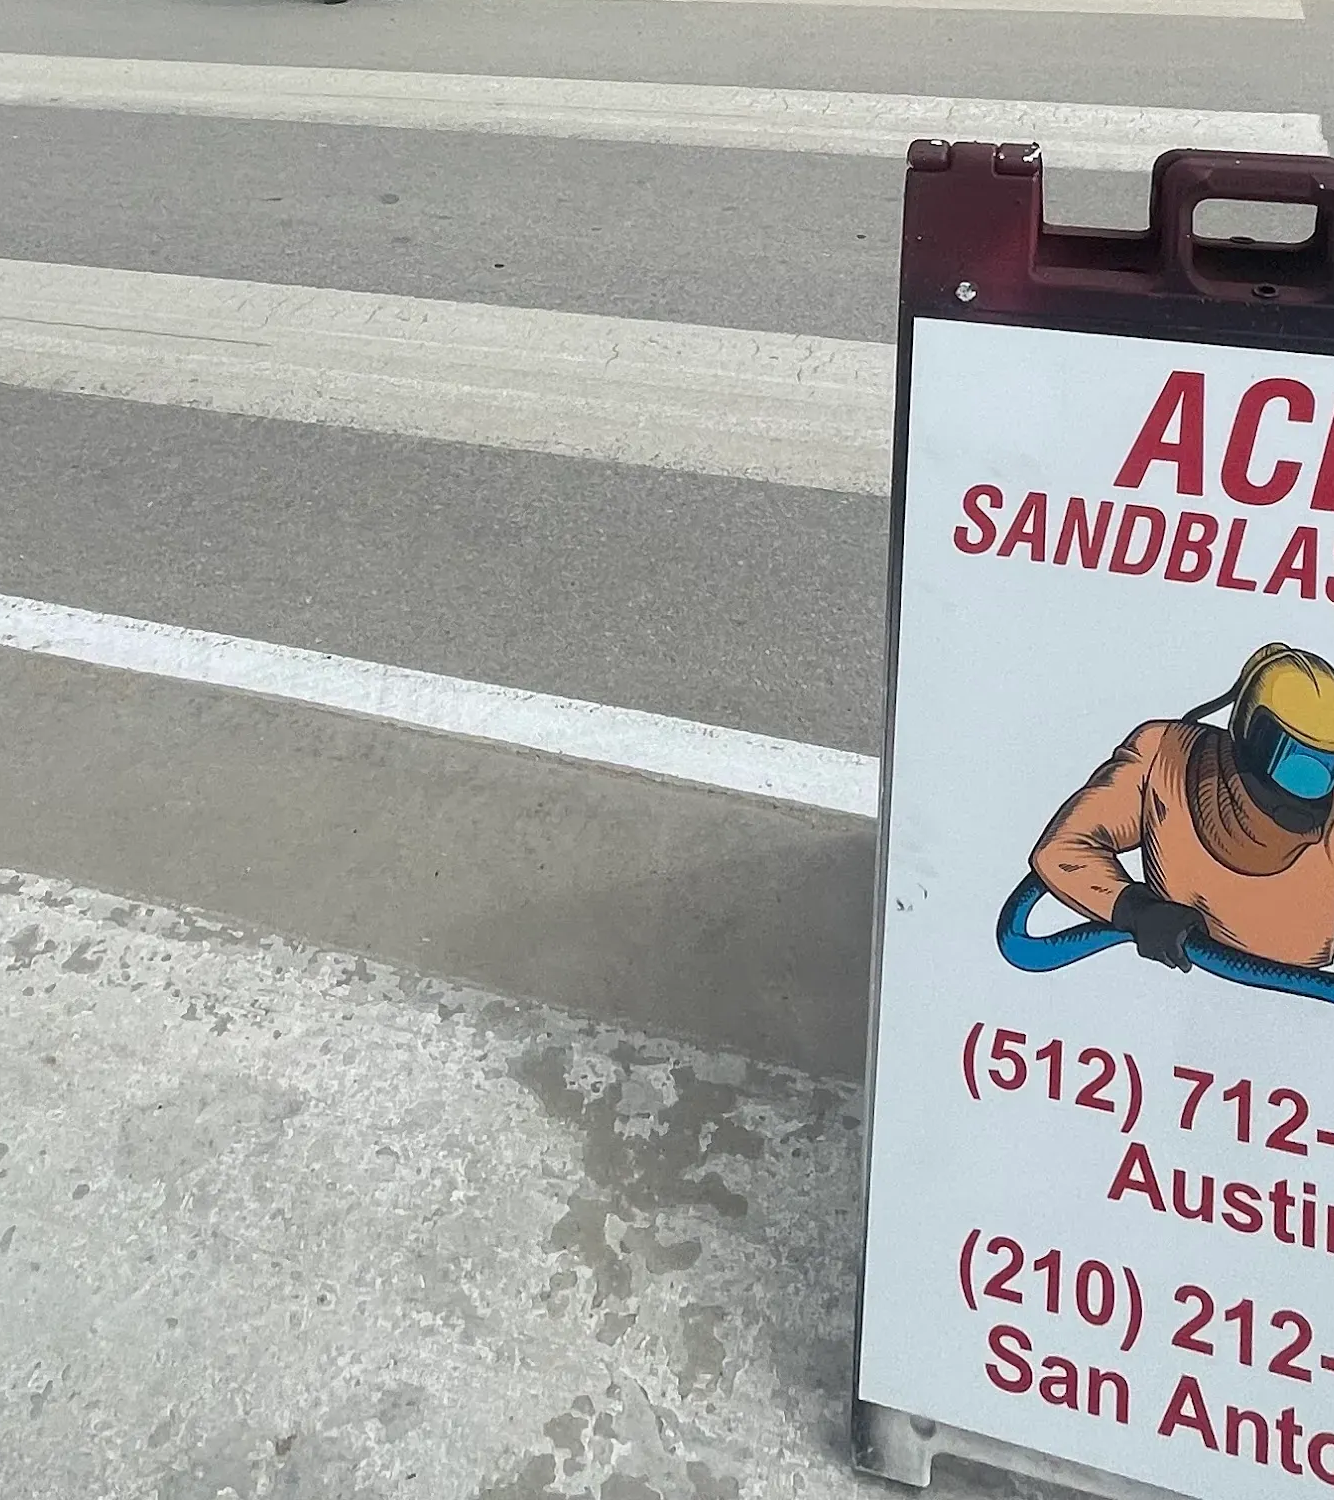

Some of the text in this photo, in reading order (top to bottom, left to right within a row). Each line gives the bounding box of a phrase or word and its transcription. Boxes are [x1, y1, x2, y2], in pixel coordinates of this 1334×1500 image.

[962, 1022, 1144, 1134] (512)
[959, 1229, 1144, 1351] (210)
[985, 1324, 1130, 1424] San
